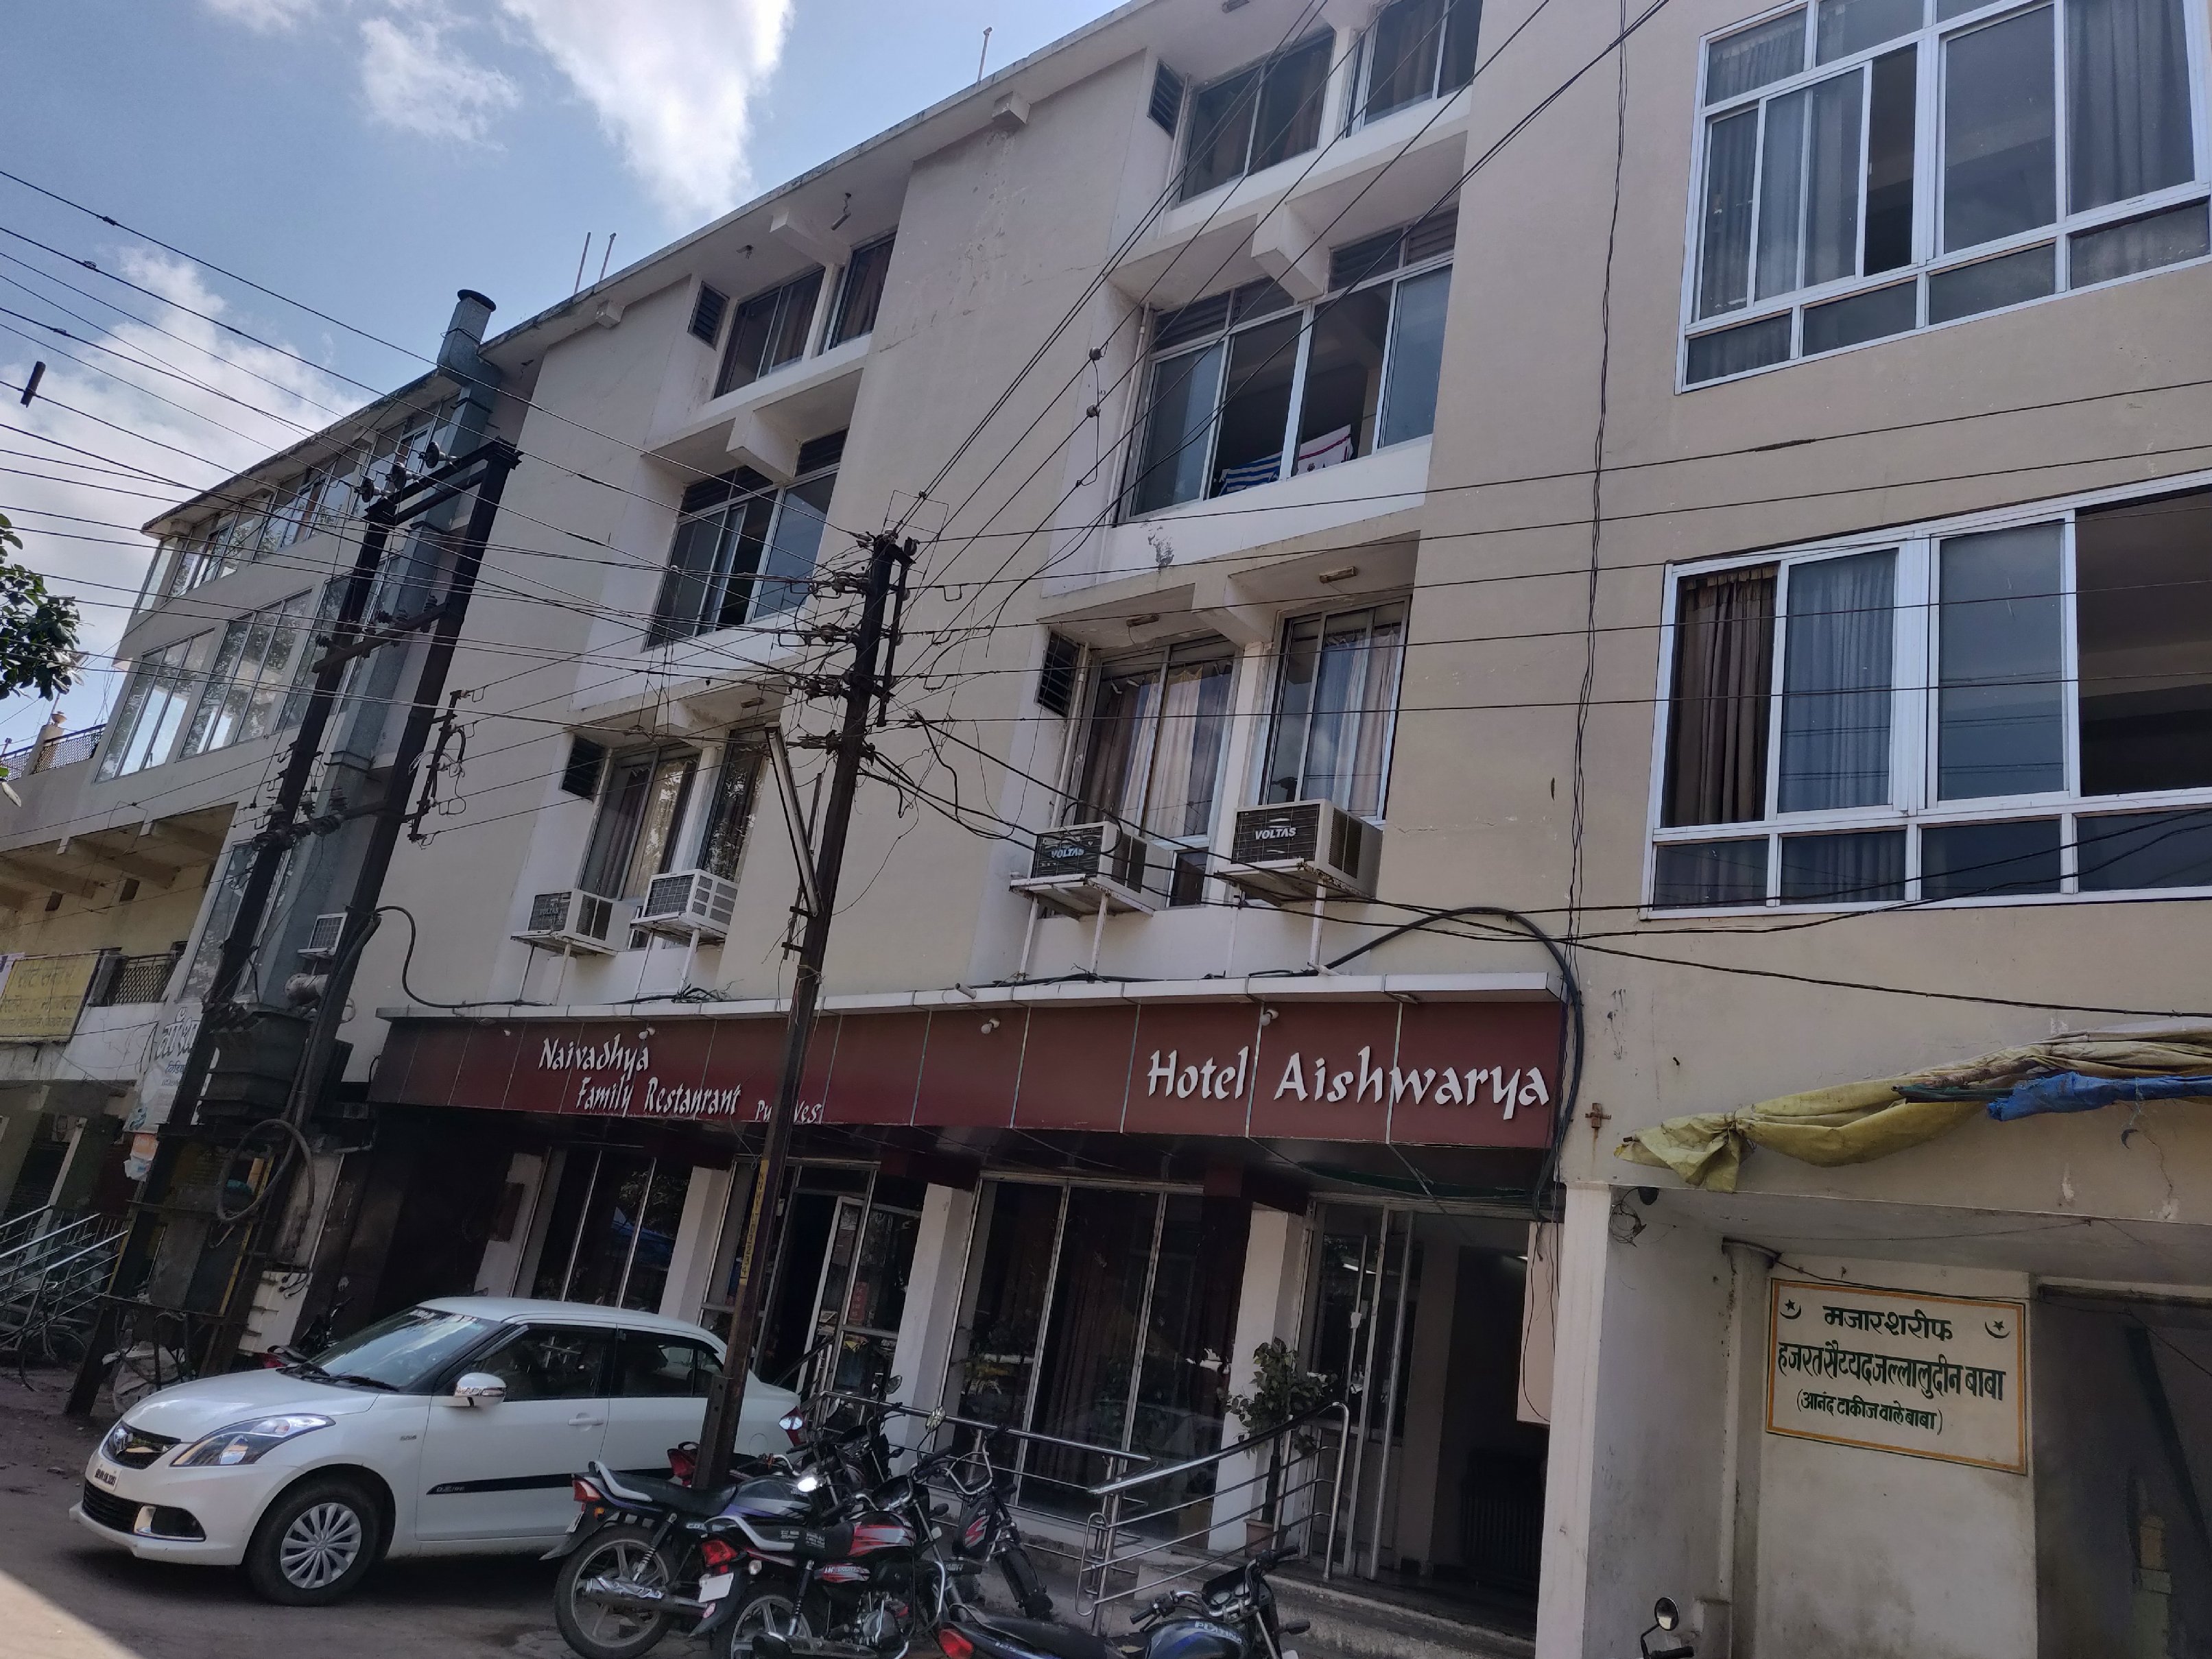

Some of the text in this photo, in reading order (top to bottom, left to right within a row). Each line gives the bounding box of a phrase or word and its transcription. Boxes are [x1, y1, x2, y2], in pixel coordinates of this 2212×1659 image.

[1051, 847, 1085, 859] VOLTAS
[1255, 827, 1296, 840] VOLTAS
[538, 1033, 649, 1081] Naivadhya
[1147, 1046, 1249, 1100] Hotel
[575, 1073, 634, 1118] Family
[1274, 1046, 1549, 1121] Aishwarya
[1822, 1305, 1953, 1342] मजार शरीफ
[1778, 1341, 1824, 1377] हजरत
[1964, 1365, 2007, 1402] बाबा
[1836, 1394, 1880, 1420] टाकीज
[1879, 1400, 1905, 1425] वाले
